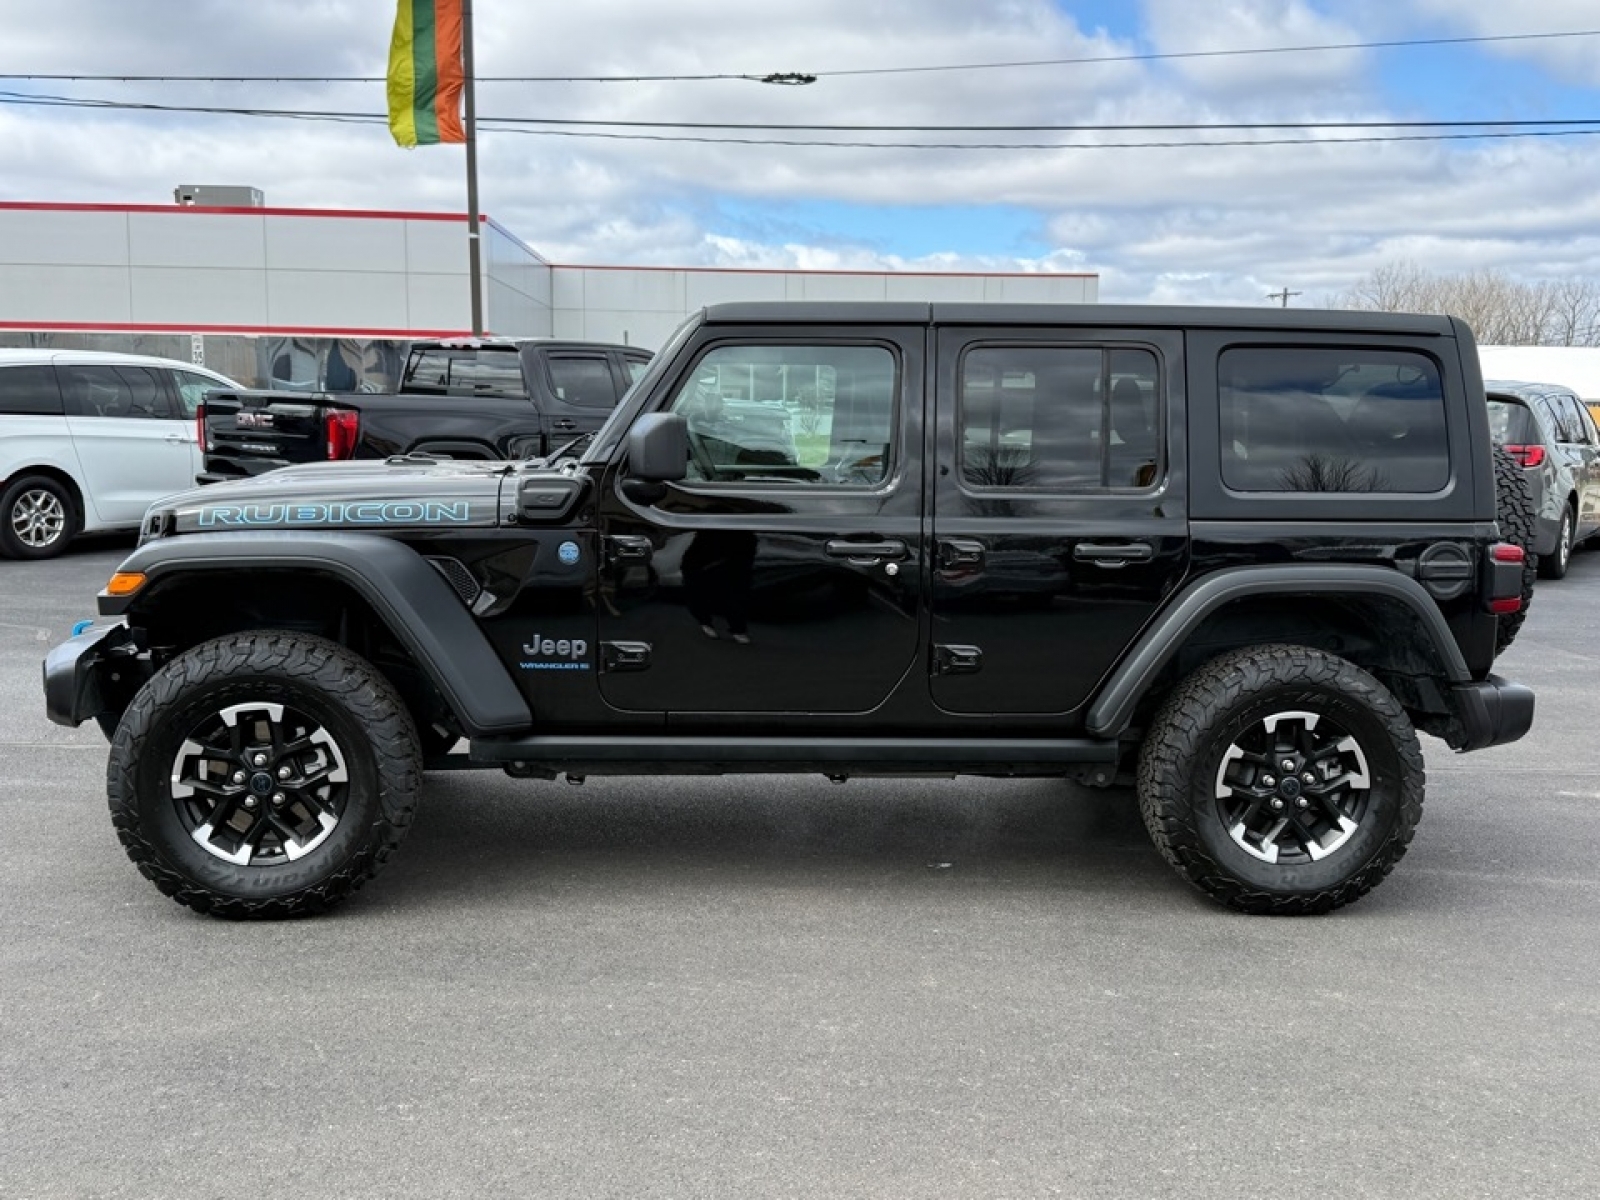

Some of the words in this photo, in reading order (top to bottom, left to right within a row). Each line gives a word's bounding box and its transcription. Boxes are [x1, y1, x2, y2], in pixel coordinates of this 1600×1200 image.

[236, 412, 274, 426] GMC
[198, 502, 469, 525] RUBICON
[523, 634, 587, 659] Jeep
